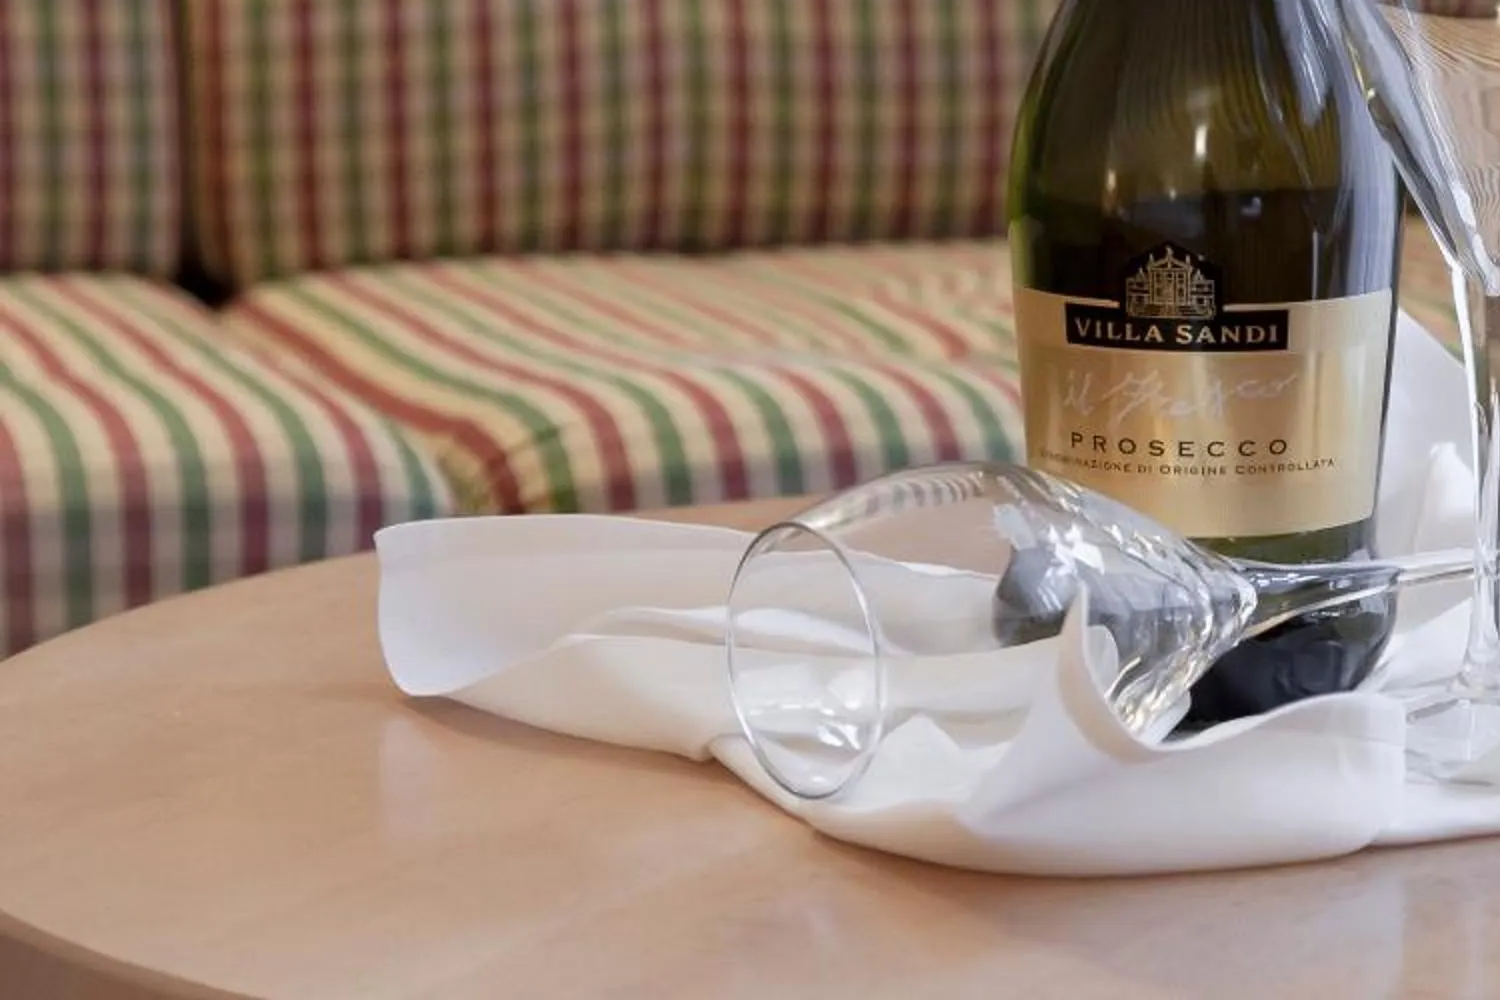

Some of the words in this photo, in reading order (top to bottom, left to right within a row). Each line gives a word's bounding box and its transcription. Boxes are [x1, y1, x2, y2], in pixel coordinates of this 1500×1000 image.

[1074, 317, 1164, 342] VILLA
[1175, 324, 1278, 345] SANDI
[1071, 431, 1288, 457] PROSECCO
[1040, 449, 1132, 473] DNAZIONE
[1138, 463, 1152, 474] DI
[1159, 463, 1227, 476] ORIGINE
[1235, 457, 1335, 475] CONTROLLATA
